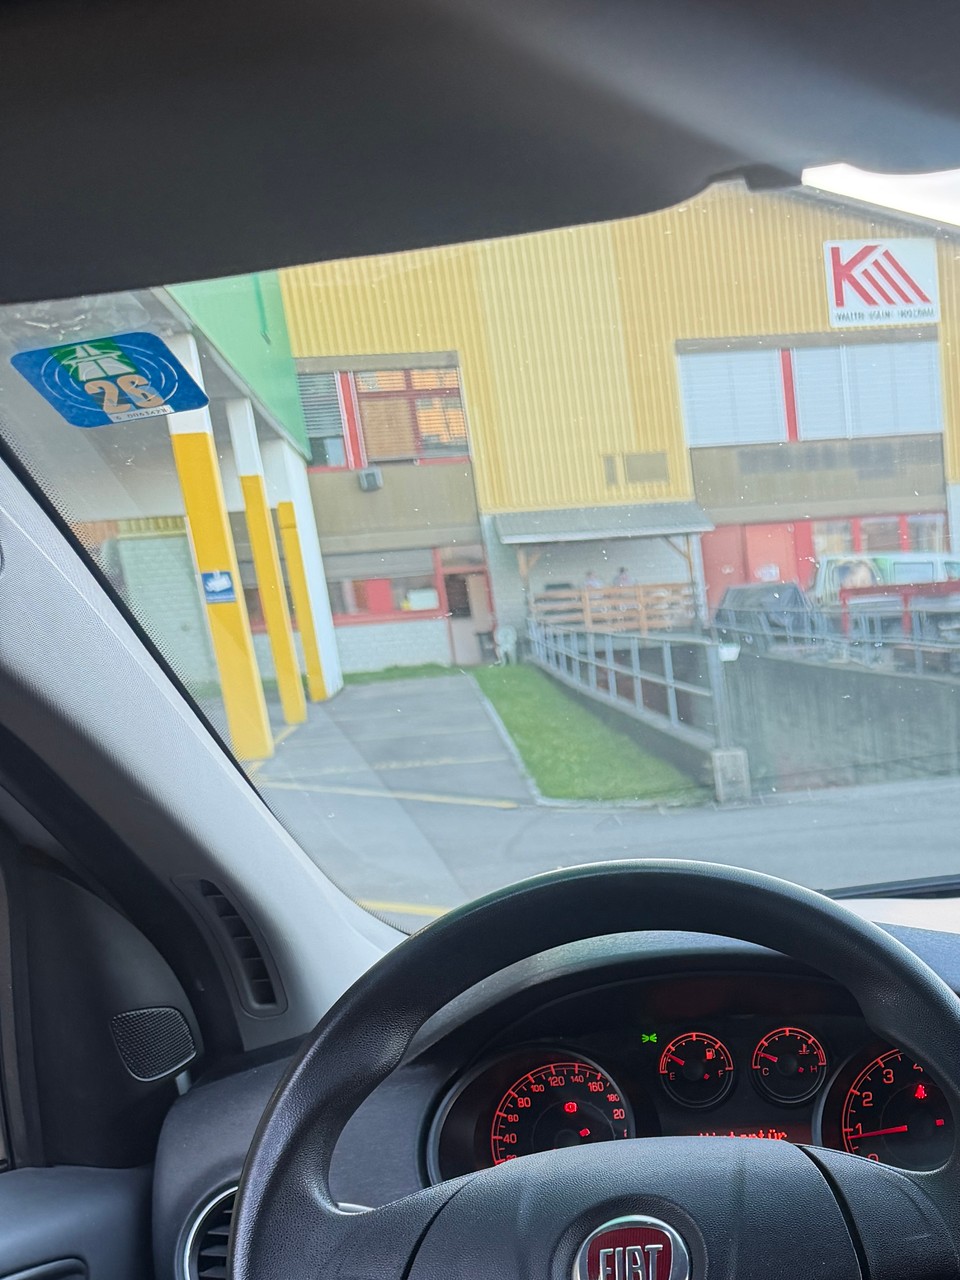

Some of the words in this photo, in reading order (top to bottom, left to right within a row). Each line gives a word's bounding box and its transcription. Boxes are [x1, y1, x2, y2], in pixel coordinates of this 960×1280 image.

[84, 374, 165, 414] 26
[717, 1069, 724, 1078] F
[762, 1067, 770, 1076] C
[810, 1065, 818, 1073] H
[547, 1076, 565, 1087] 120
[570, 1075, 584, 1083] 140
[669, 1072, 676, 1081] E
[882, 1068, 894, 1084] 3
[530, 1084, 545, 1093] 100
[587, 1081, 604, 1093] 160
[517, 1097, 531, 1108] 80
[862, 1091, 874, 1107] 2
[507, 1114, 519, 1122] 60
[612, 1108, 625, 1119] 20
[855, 1122, 863, 1135] 1
[503, 1133, 517, 1144] 40
